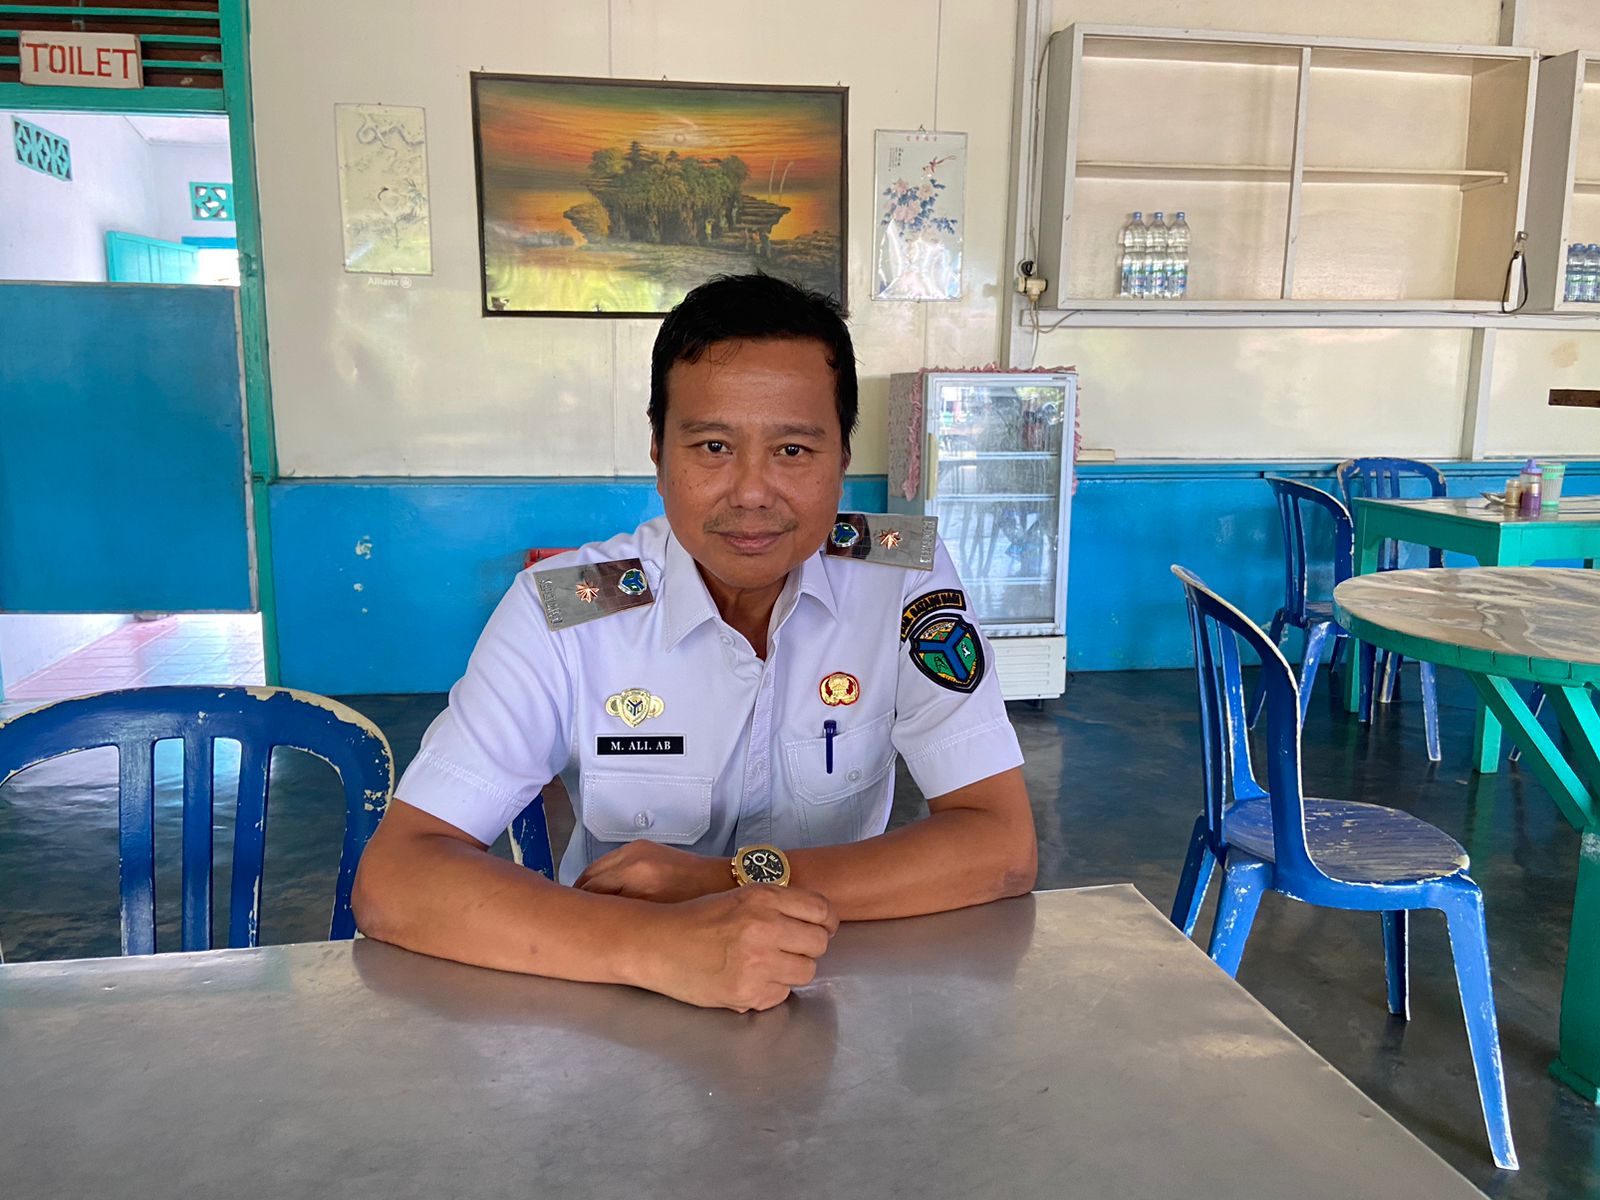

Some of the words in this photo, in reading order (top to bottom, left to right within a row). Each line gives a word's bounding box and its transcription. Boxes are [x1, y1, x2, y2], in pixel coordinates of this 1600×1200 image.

[25, 43, 137, 79] TOILET
[368, 277, 399, 286] Allianz
[610, 741, 625, 751] M.
[629, 741, 652, 751] ALI.
[656, 740, 671, 751] AB
